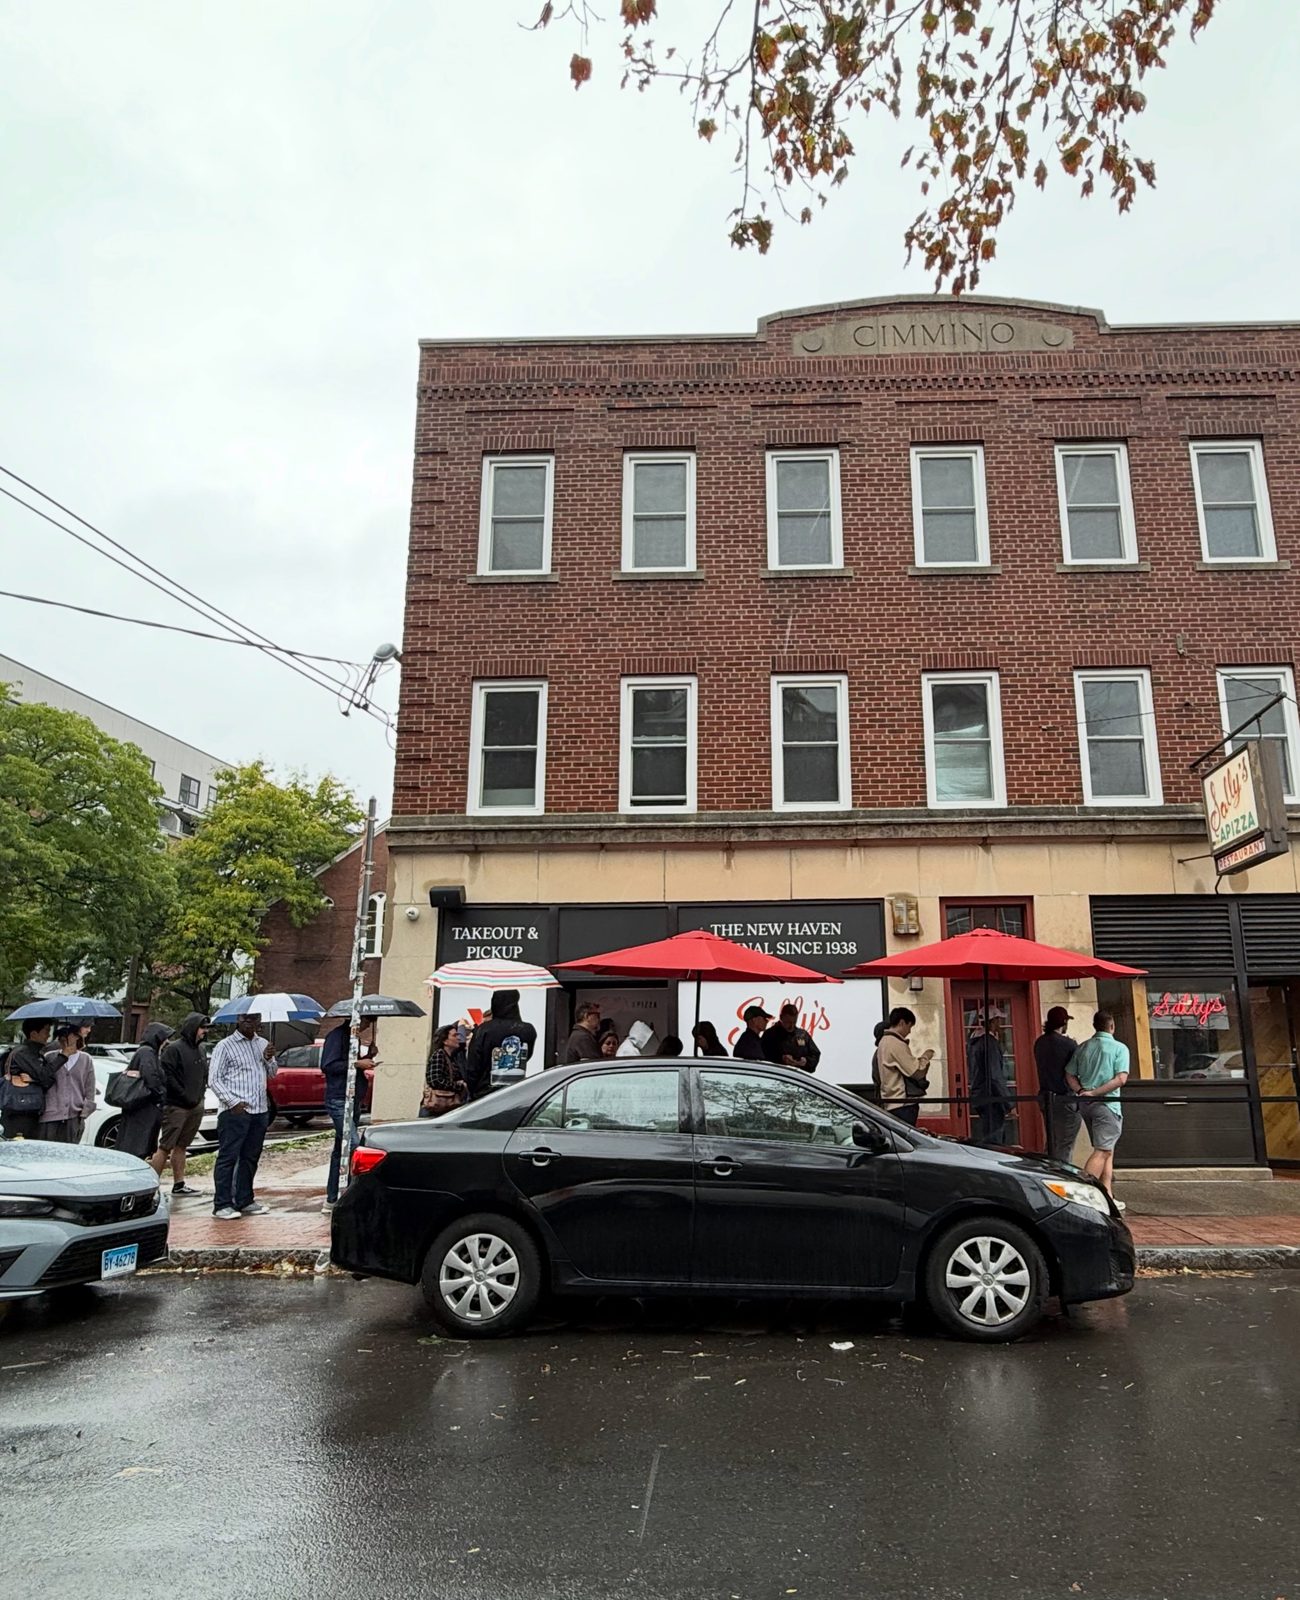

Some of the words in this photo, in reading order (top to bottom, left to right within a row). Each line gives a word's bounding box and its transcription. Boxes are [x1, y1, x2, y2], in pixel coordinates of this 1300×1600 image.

[853, 322, 1015, 347] CIMMINO
[1210, 756, 1248, 837] Sally's
[1220, 811, 1256, 842] APIZZA
[1219, 839, 1265, 868] RESTAURANT
[452, 926, 525, 940] TAKEOUT
[527, 926, 539, 940] &
[710, 923, 745, 937] THE
[747, 922, 784, 936] NEW
[787, 922, 842, 936] HAVEN
[466, 946, 523, 959] PICKUP
[776, 941, 823, 955] SINCE
[825, 941, 857, 955] 1938
